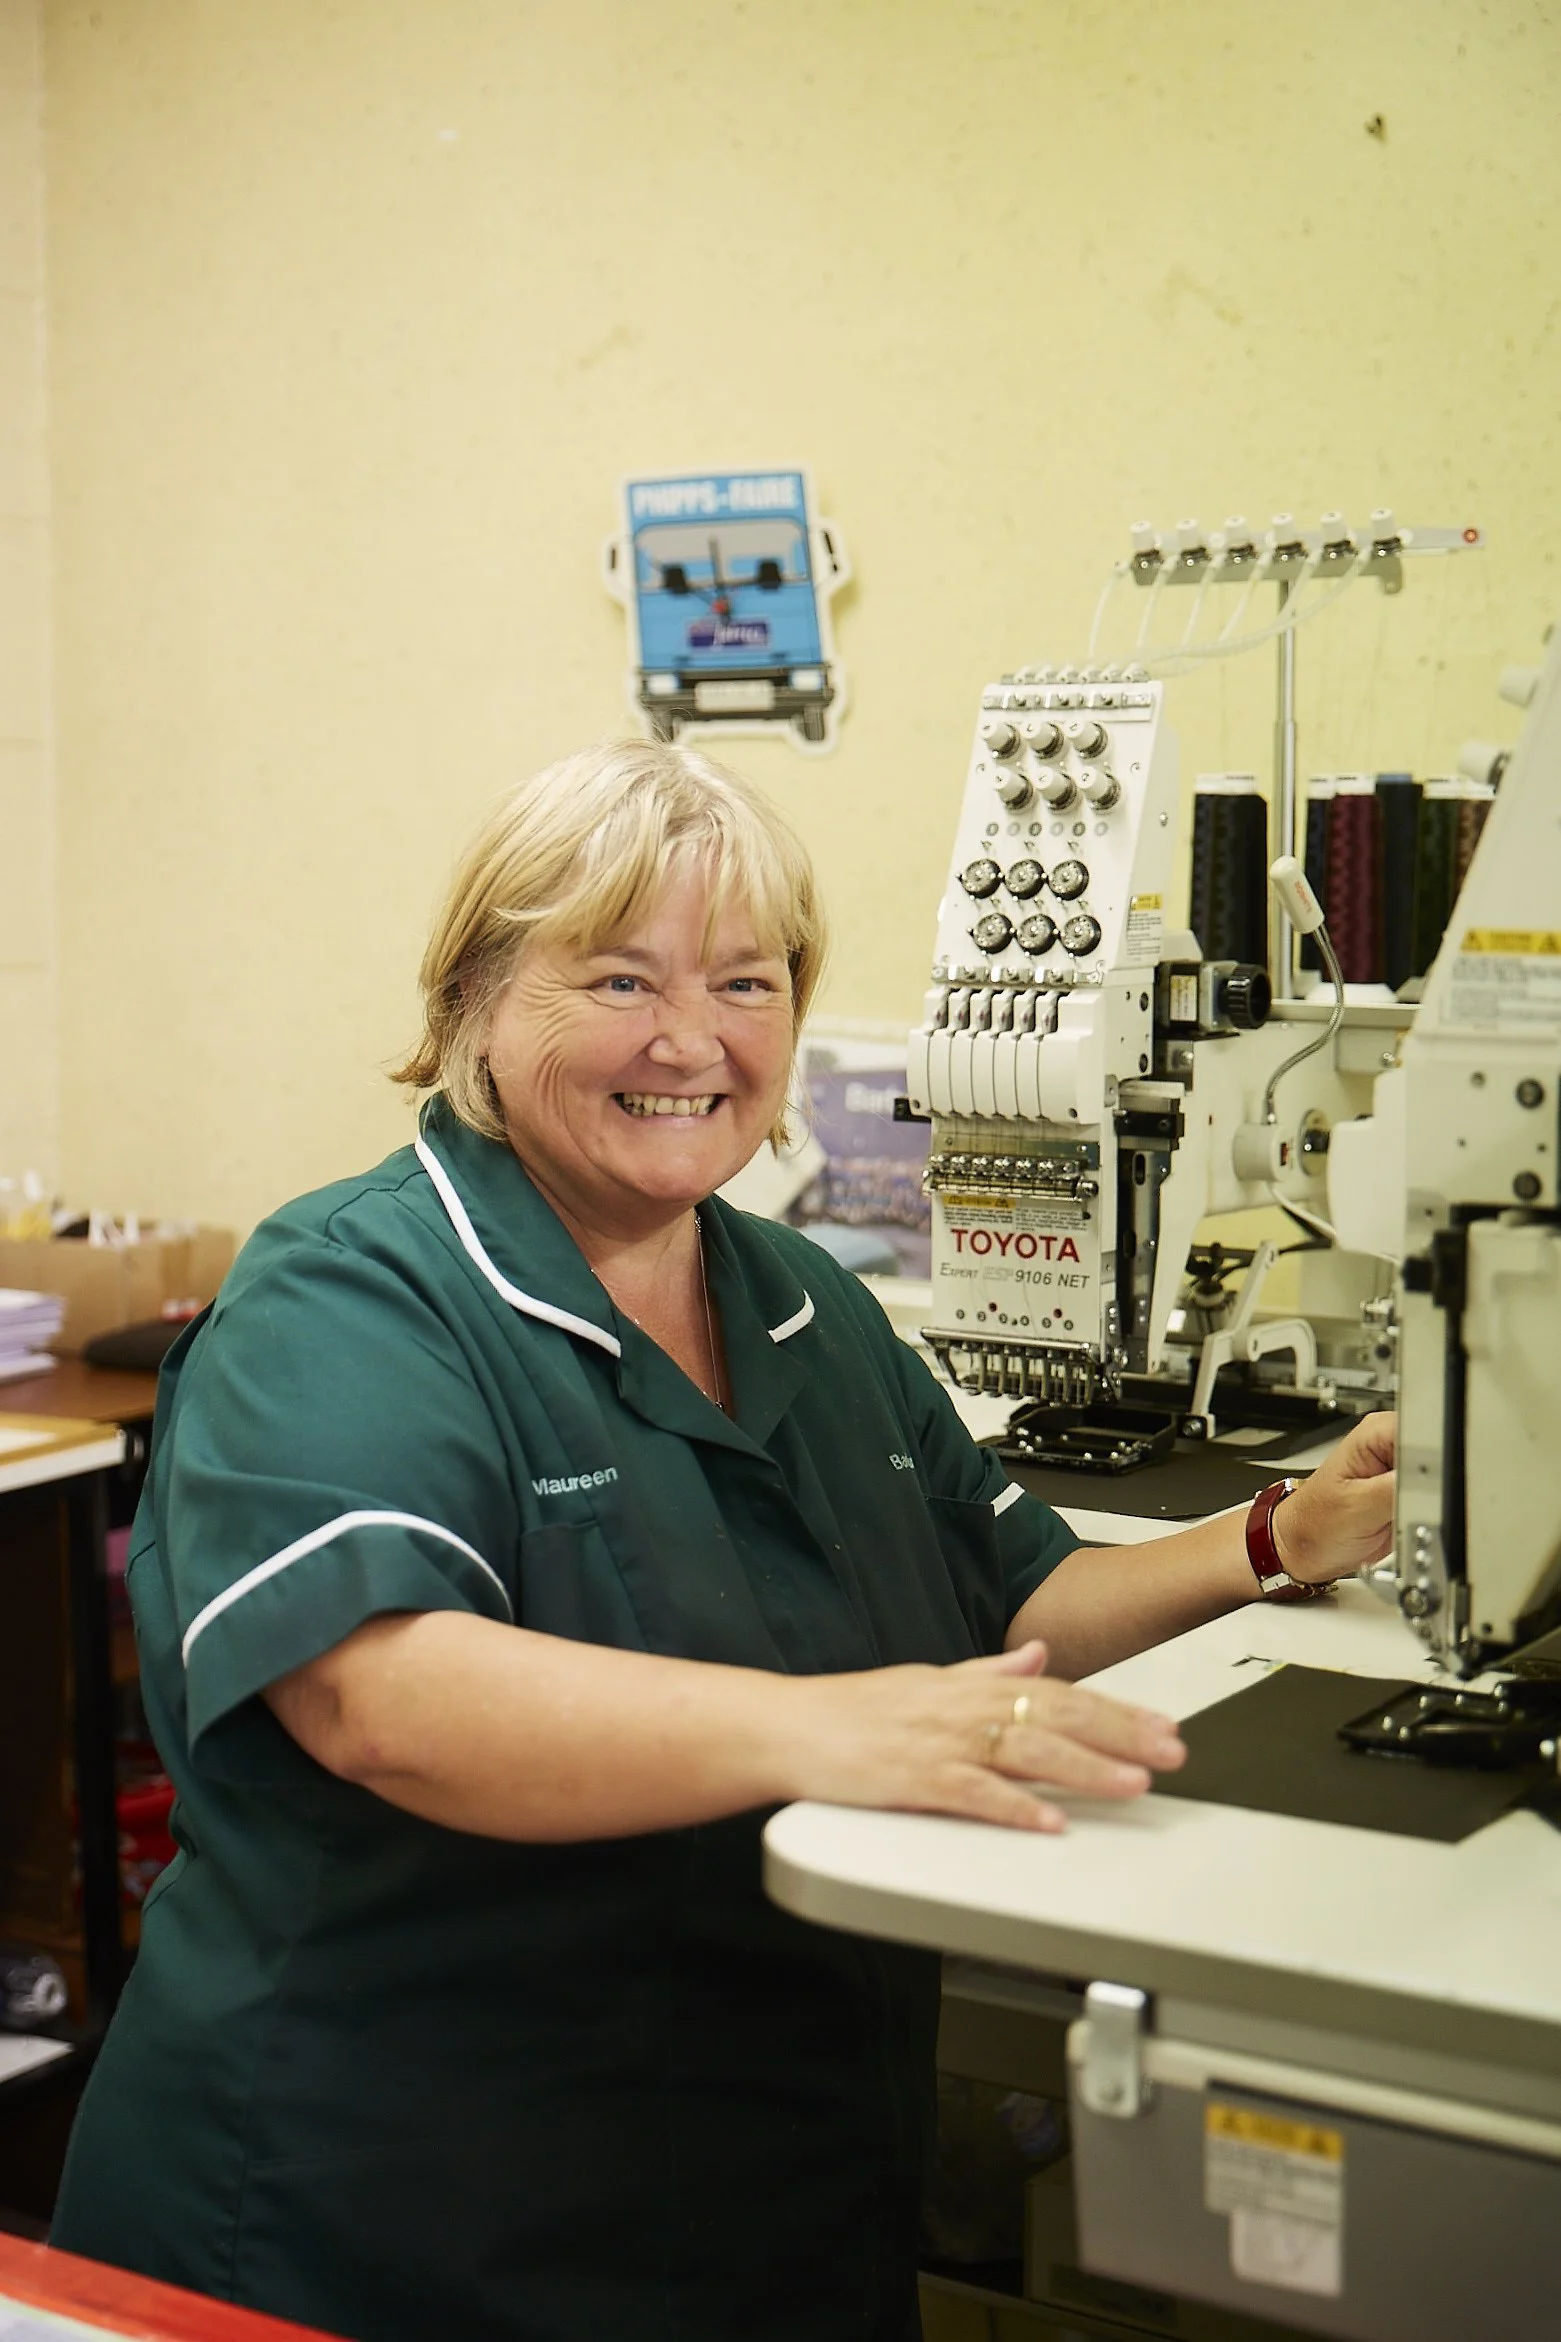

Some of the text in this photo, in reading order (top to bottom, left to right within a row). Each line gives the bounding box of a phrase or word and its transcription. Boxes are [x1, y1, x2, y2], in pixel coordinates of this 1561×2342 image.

[950, 1228, 1080, 1263] TOYOTA
[1015, 1269, 1052, 1285] 9106
[1057, 1273, 1090, 1289] NET
